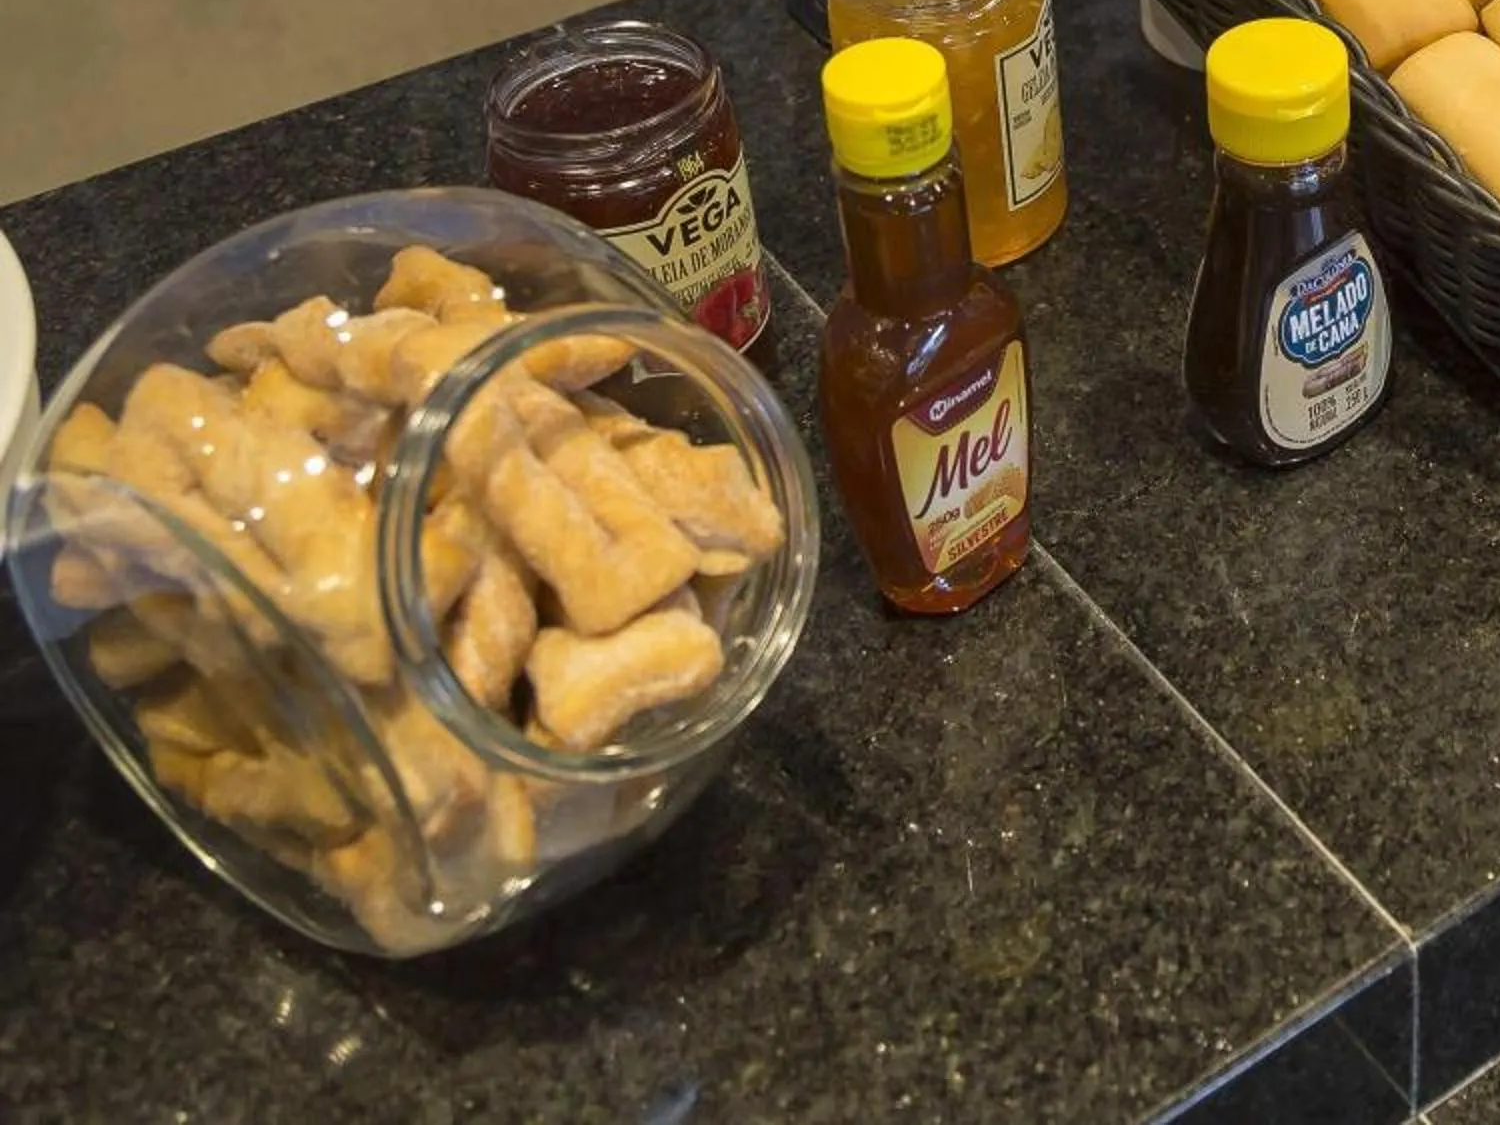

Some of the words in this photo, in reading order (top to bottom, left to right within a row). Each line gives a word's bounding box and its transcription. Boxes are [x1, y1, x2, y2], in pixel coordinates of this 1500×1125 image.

[646, 186, 741, 256] VEGA
[651, 258, 689, 285] LEIA
[691, 246, 711, 274] DE
[1289, 272, 1368, 344] MELADO
[1305, 339, 1318, 354] DE
[1318, 312, 1360, 353] CANA
[913, 398, 1013, 520] Mel
[947, 507, 1009, 562] SILVESTRE
